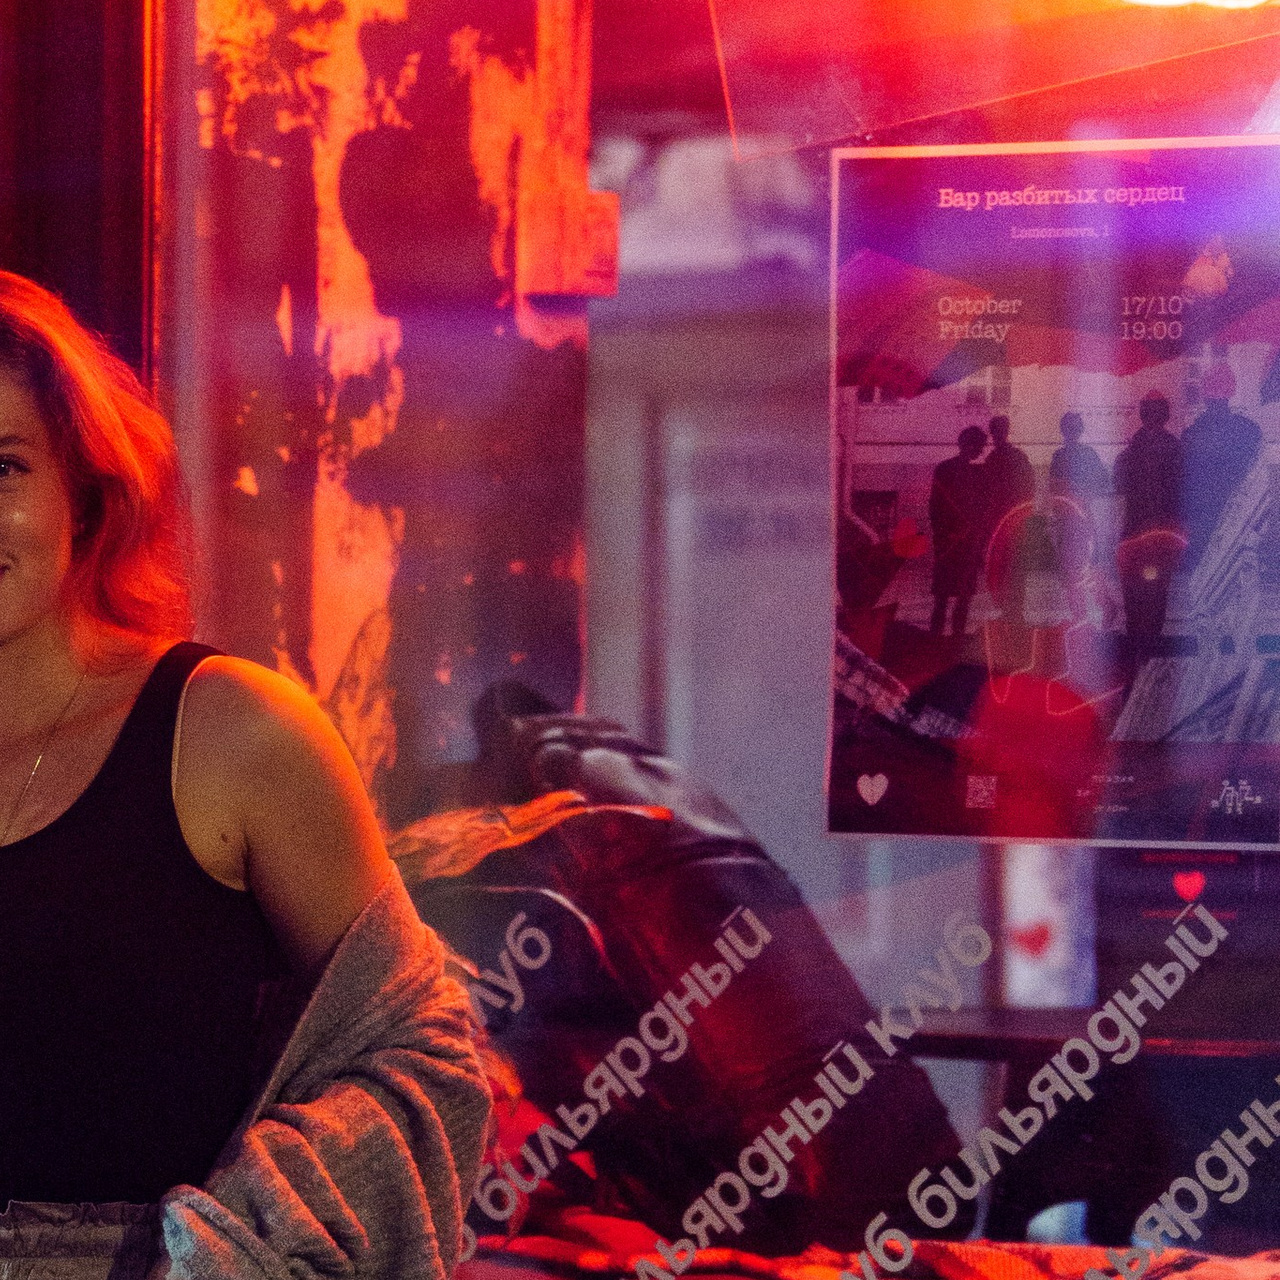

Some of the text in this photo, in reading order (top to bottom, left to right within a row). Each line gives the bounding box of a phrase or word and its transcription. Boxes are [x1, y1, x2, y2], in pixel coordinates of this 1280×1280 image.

[984, 183, 1098, 210] разбитых
[1103, 186, 1185, 207] сердец
[937, 296, 1023, 316] October
[1122, 295, 1183, 320] 17/10
[938, 321, 1011, 343] Friday
[1121, 321, 1183, 341] 19:00
[469, 911, 552, 1028] луб
[864, 912, 993, 1057] клуб
[472, 905, 773, 1221] бильярдный
[907, 903, 1230, 1229] бильярдный
